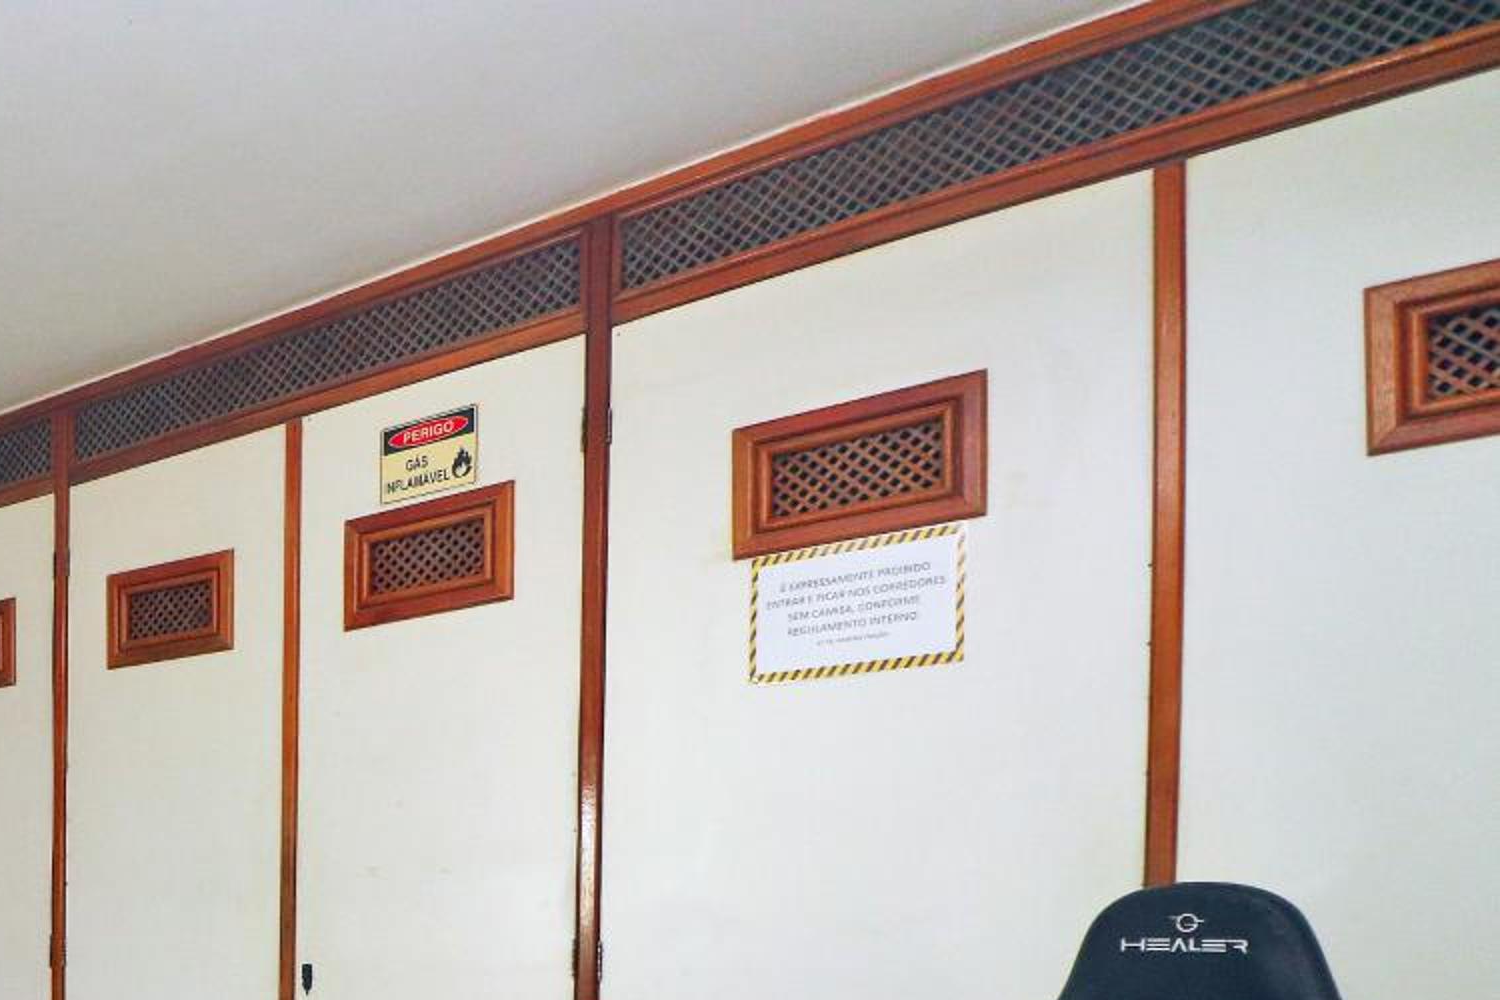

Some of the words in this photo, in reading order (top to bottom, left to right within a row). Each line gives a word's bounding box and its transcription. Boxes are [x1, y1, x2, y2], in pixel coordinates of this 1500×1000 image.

[402, 420, 455, 444] PERIGO
[847, 585, 871, 598] NOS
[873, 575, 945, 594] CORREDORES
[787, 610, 810, 622] SEM
[1120, 937, 1249, 954] HEALER
